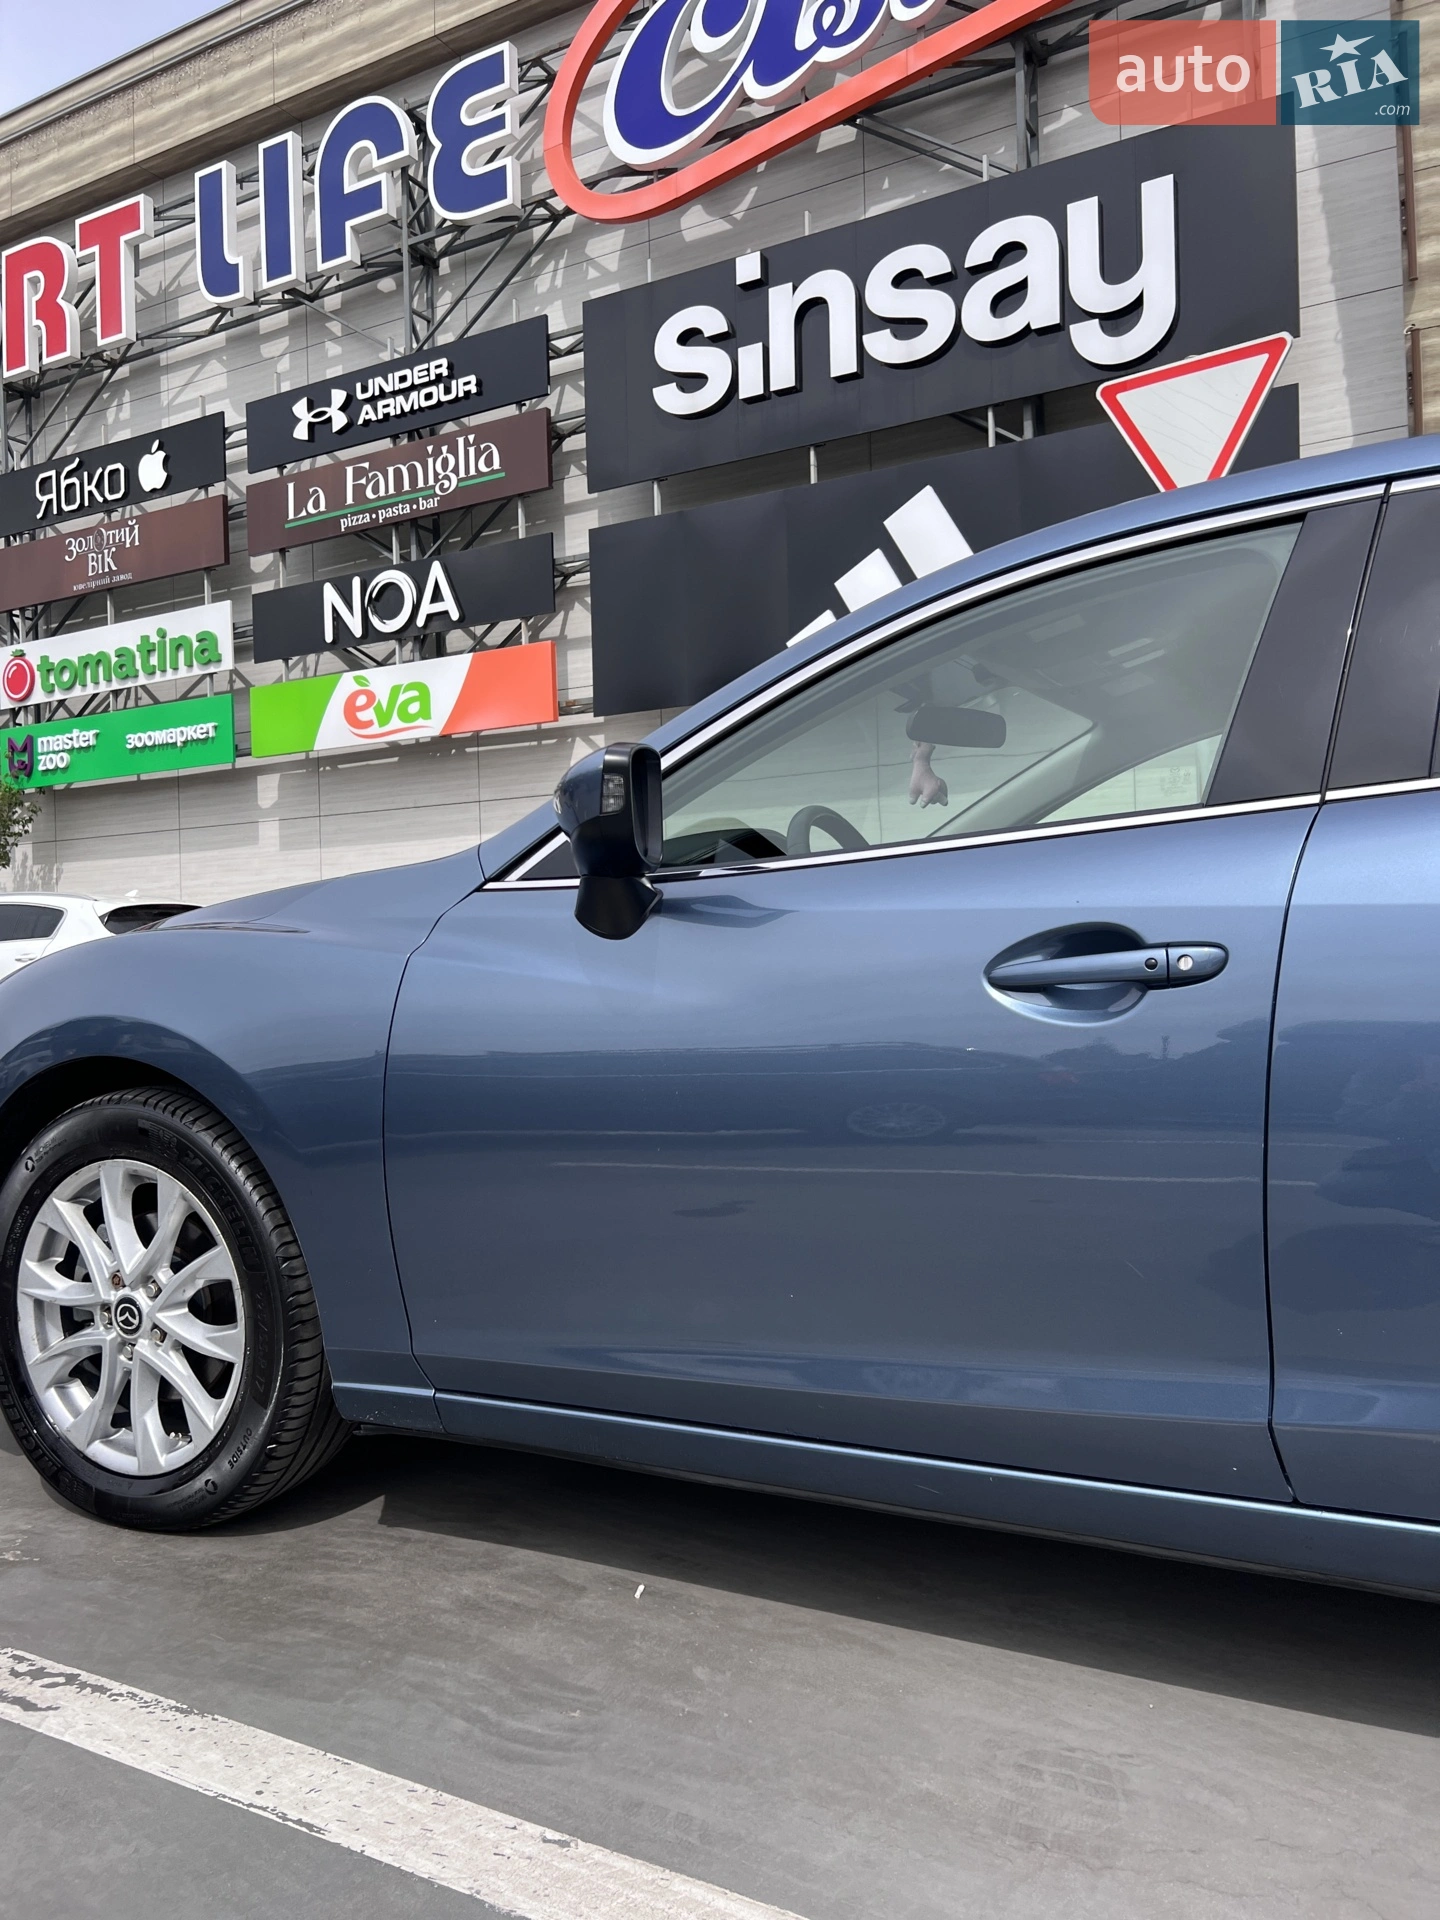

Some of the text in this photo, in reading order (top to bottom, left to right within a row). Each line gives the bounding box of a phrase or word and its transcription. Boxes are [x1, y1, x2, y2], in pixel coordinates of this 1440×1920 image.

[195, 41, 521, 308] LIFE
[652, 173, 1179, 416] sinsay
[355, 357, 449, 401] UNDER
[357, 374, 478, 426] ARMOUR
[35, 457, 127, 520] Ябко
[286, 433, 502, 521] La Famiglia
[340, 496, 440, 532] pizza pasta bar
[323, 560, 461, 644] NOA
[37, 627, 222, 694] tomatina
[38, 728, 100, 753] master
[125, 722, 218, 748] зоомаркет
[38, 752, 71, 771] zoo
[227, 1427, 252, 1470] OUTSIDE
